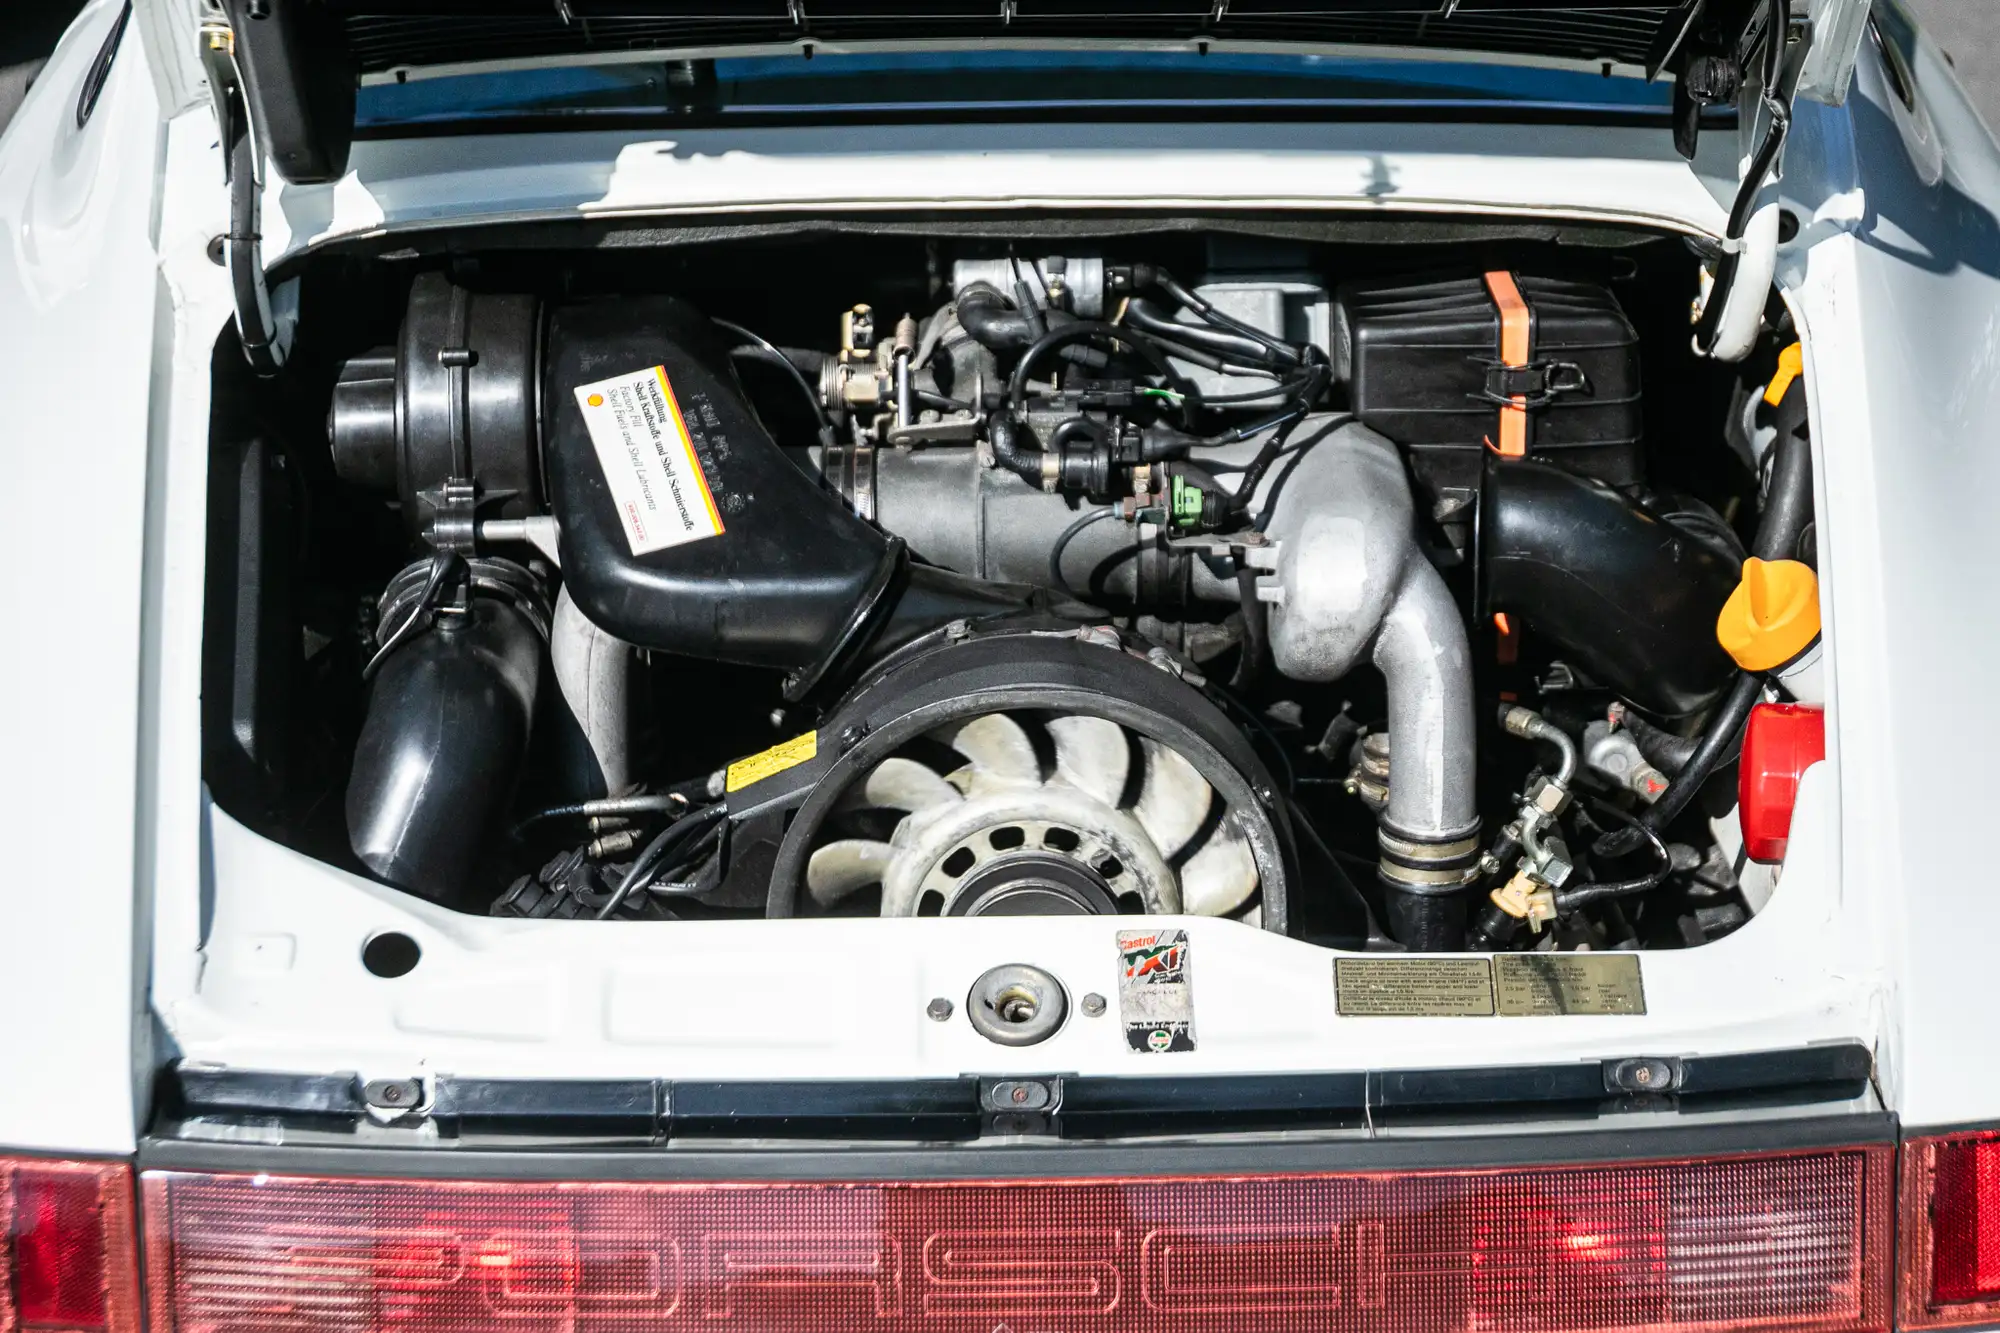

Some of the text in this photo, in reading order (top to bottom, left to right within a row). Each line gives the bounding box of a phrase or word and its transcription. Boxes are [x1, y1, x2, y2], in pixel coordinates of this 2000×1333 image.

[607, 389, 656, 510] Shell Fuels and Shell Lubricants
[620, 386, 642, 427] Factory Fill
[634, 382, 694, 530] Shell Kraftstoffe und Shell Schmierstoffe
